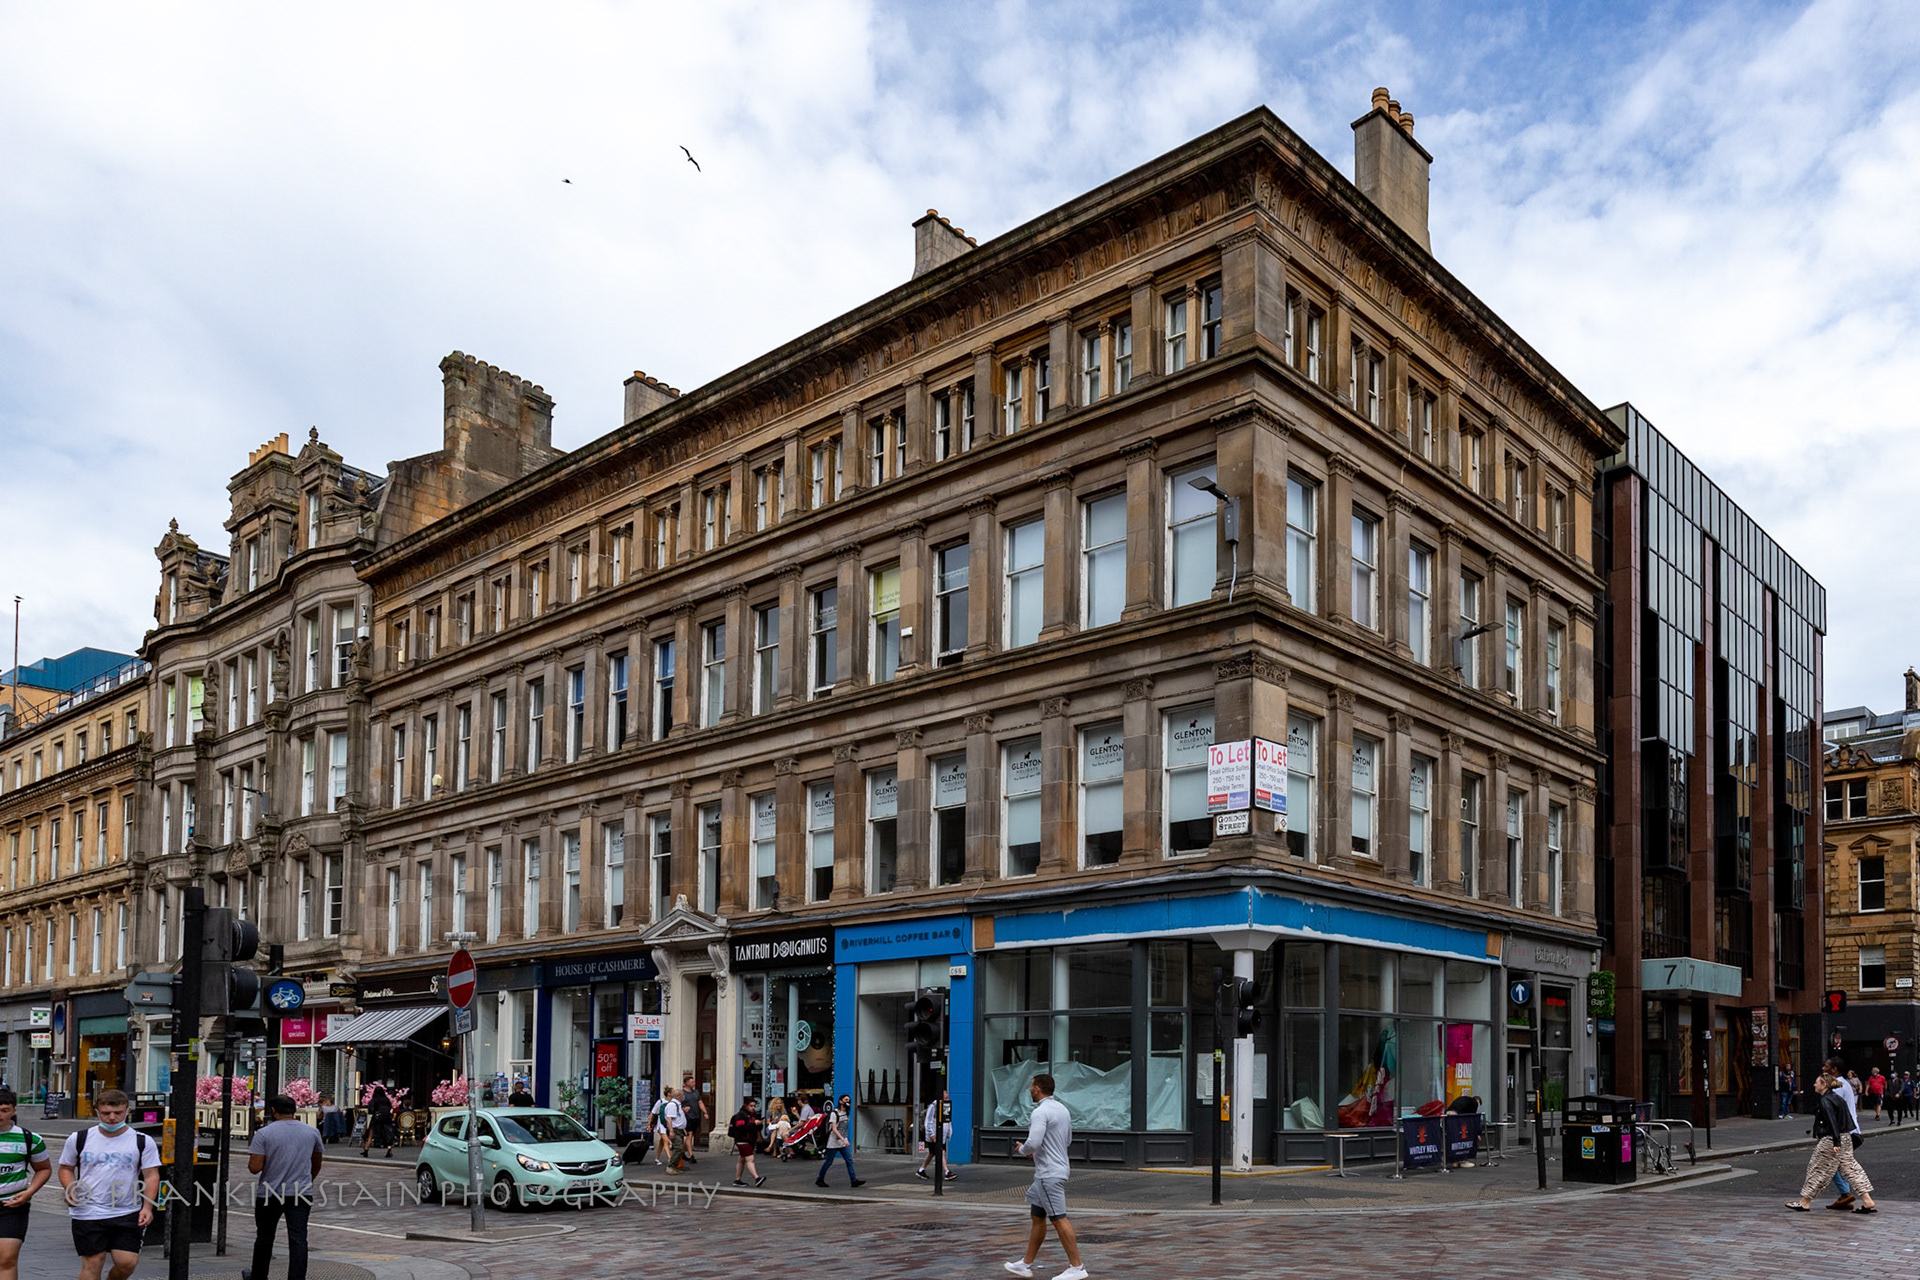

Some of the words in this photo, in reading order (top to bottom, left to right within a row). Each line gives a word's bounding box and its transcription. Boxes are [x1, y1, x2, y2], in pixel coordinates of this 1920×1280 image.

[1174, 726, 1212, 740] GLENTON
[1090, 743, 1124, 756] GLENTON
[1210, 747, 1224, 766] To
[1228, 742, 1249, 764] Let
[1256, 740, 1268, 762] To
[1271, 745, 1287, 767] Let
[1222, 765, 1235, 773] Office
[1236, 764, 1249, 772] Suites
[1218, 814, 1247, 823] GORDON
[1218, 822, 1246, 831] STREET
[849, 935, 892, 947] RIVERHILL
[895, 931, 929, 943] COFFEE
[932, 929, 951, 940] BAR
[735, 943, 770, 961] TANTRUM
[773, 937, 827, 958] DOUGHNUTS
[555, 963, 583, 977] HOUSE
[584, 962, 597, 974] OF
[598, 958, 645, 973] CASHMERE
[1664, 964, 1677, 985] 7
[1689, 964, 1695, 985] 7
[597, 1053, 617, 1062] 50%
[601, 1062, 612, 1072] off
[83, 1152, 132, 1164] BOSS
